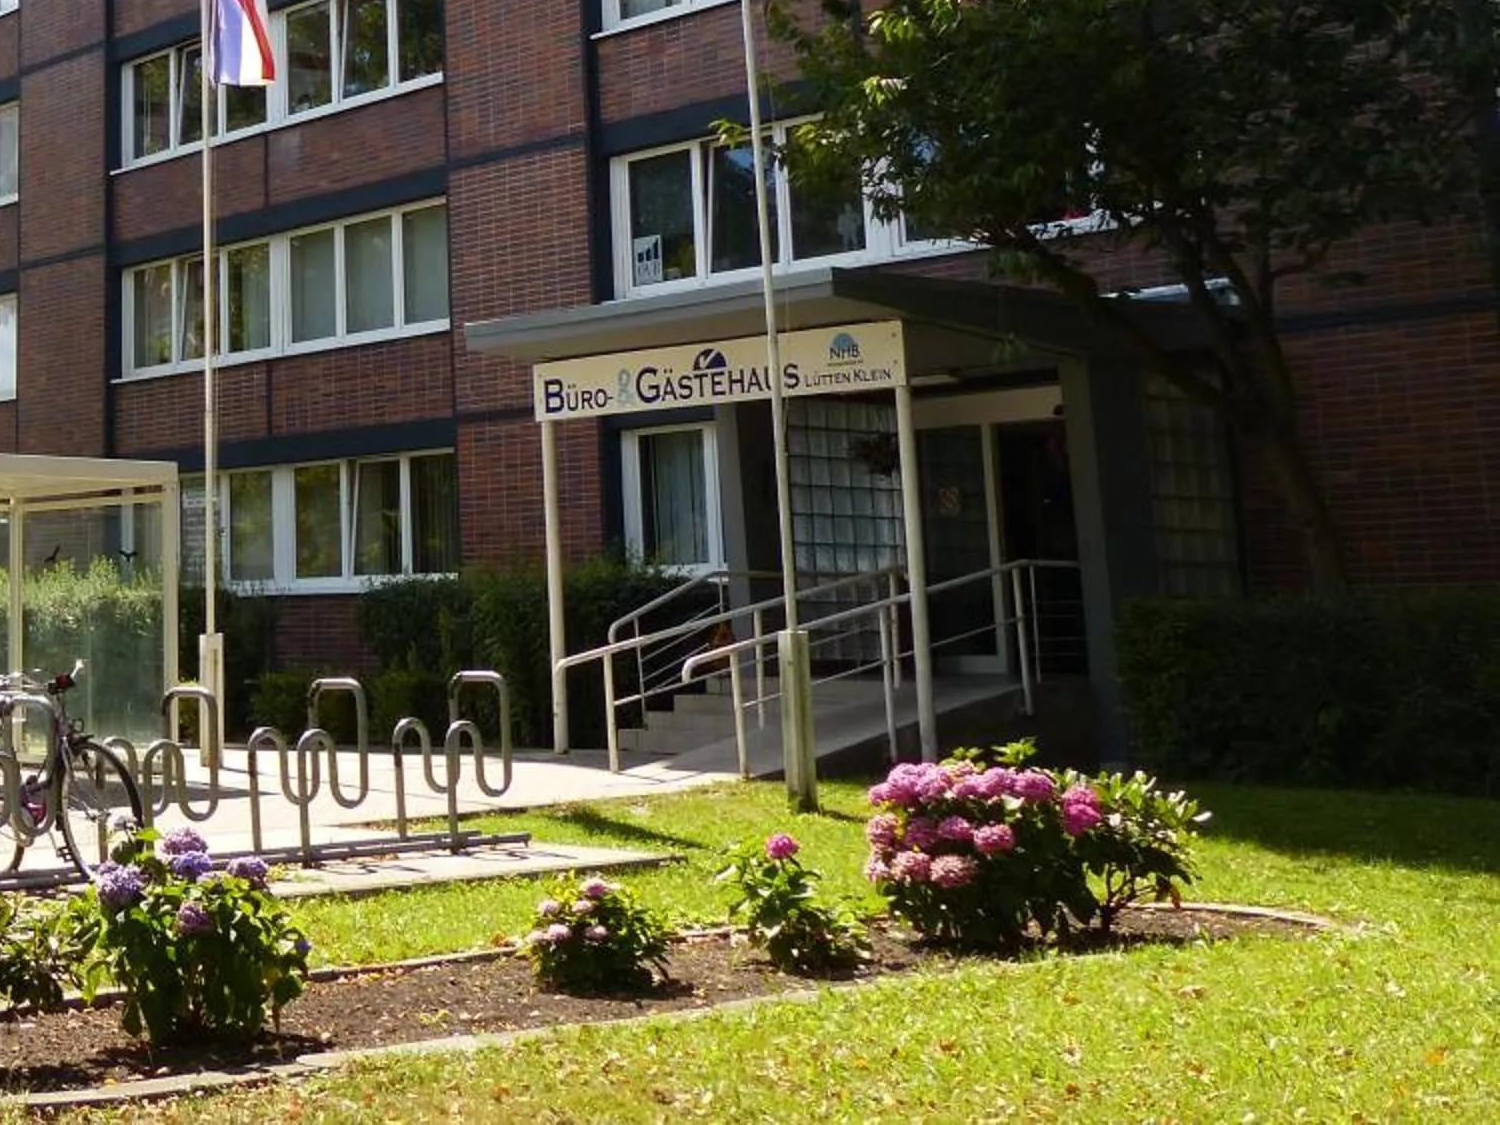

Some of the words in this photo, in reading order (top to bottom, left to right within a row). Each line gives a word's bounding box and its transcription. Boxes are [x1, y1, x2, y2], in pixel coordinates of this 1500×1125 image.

[829, 344, 860, 359] NHB
[544, 378, 613, 413] BÜRO-
[853, 368, 892, 383] KLEIN
